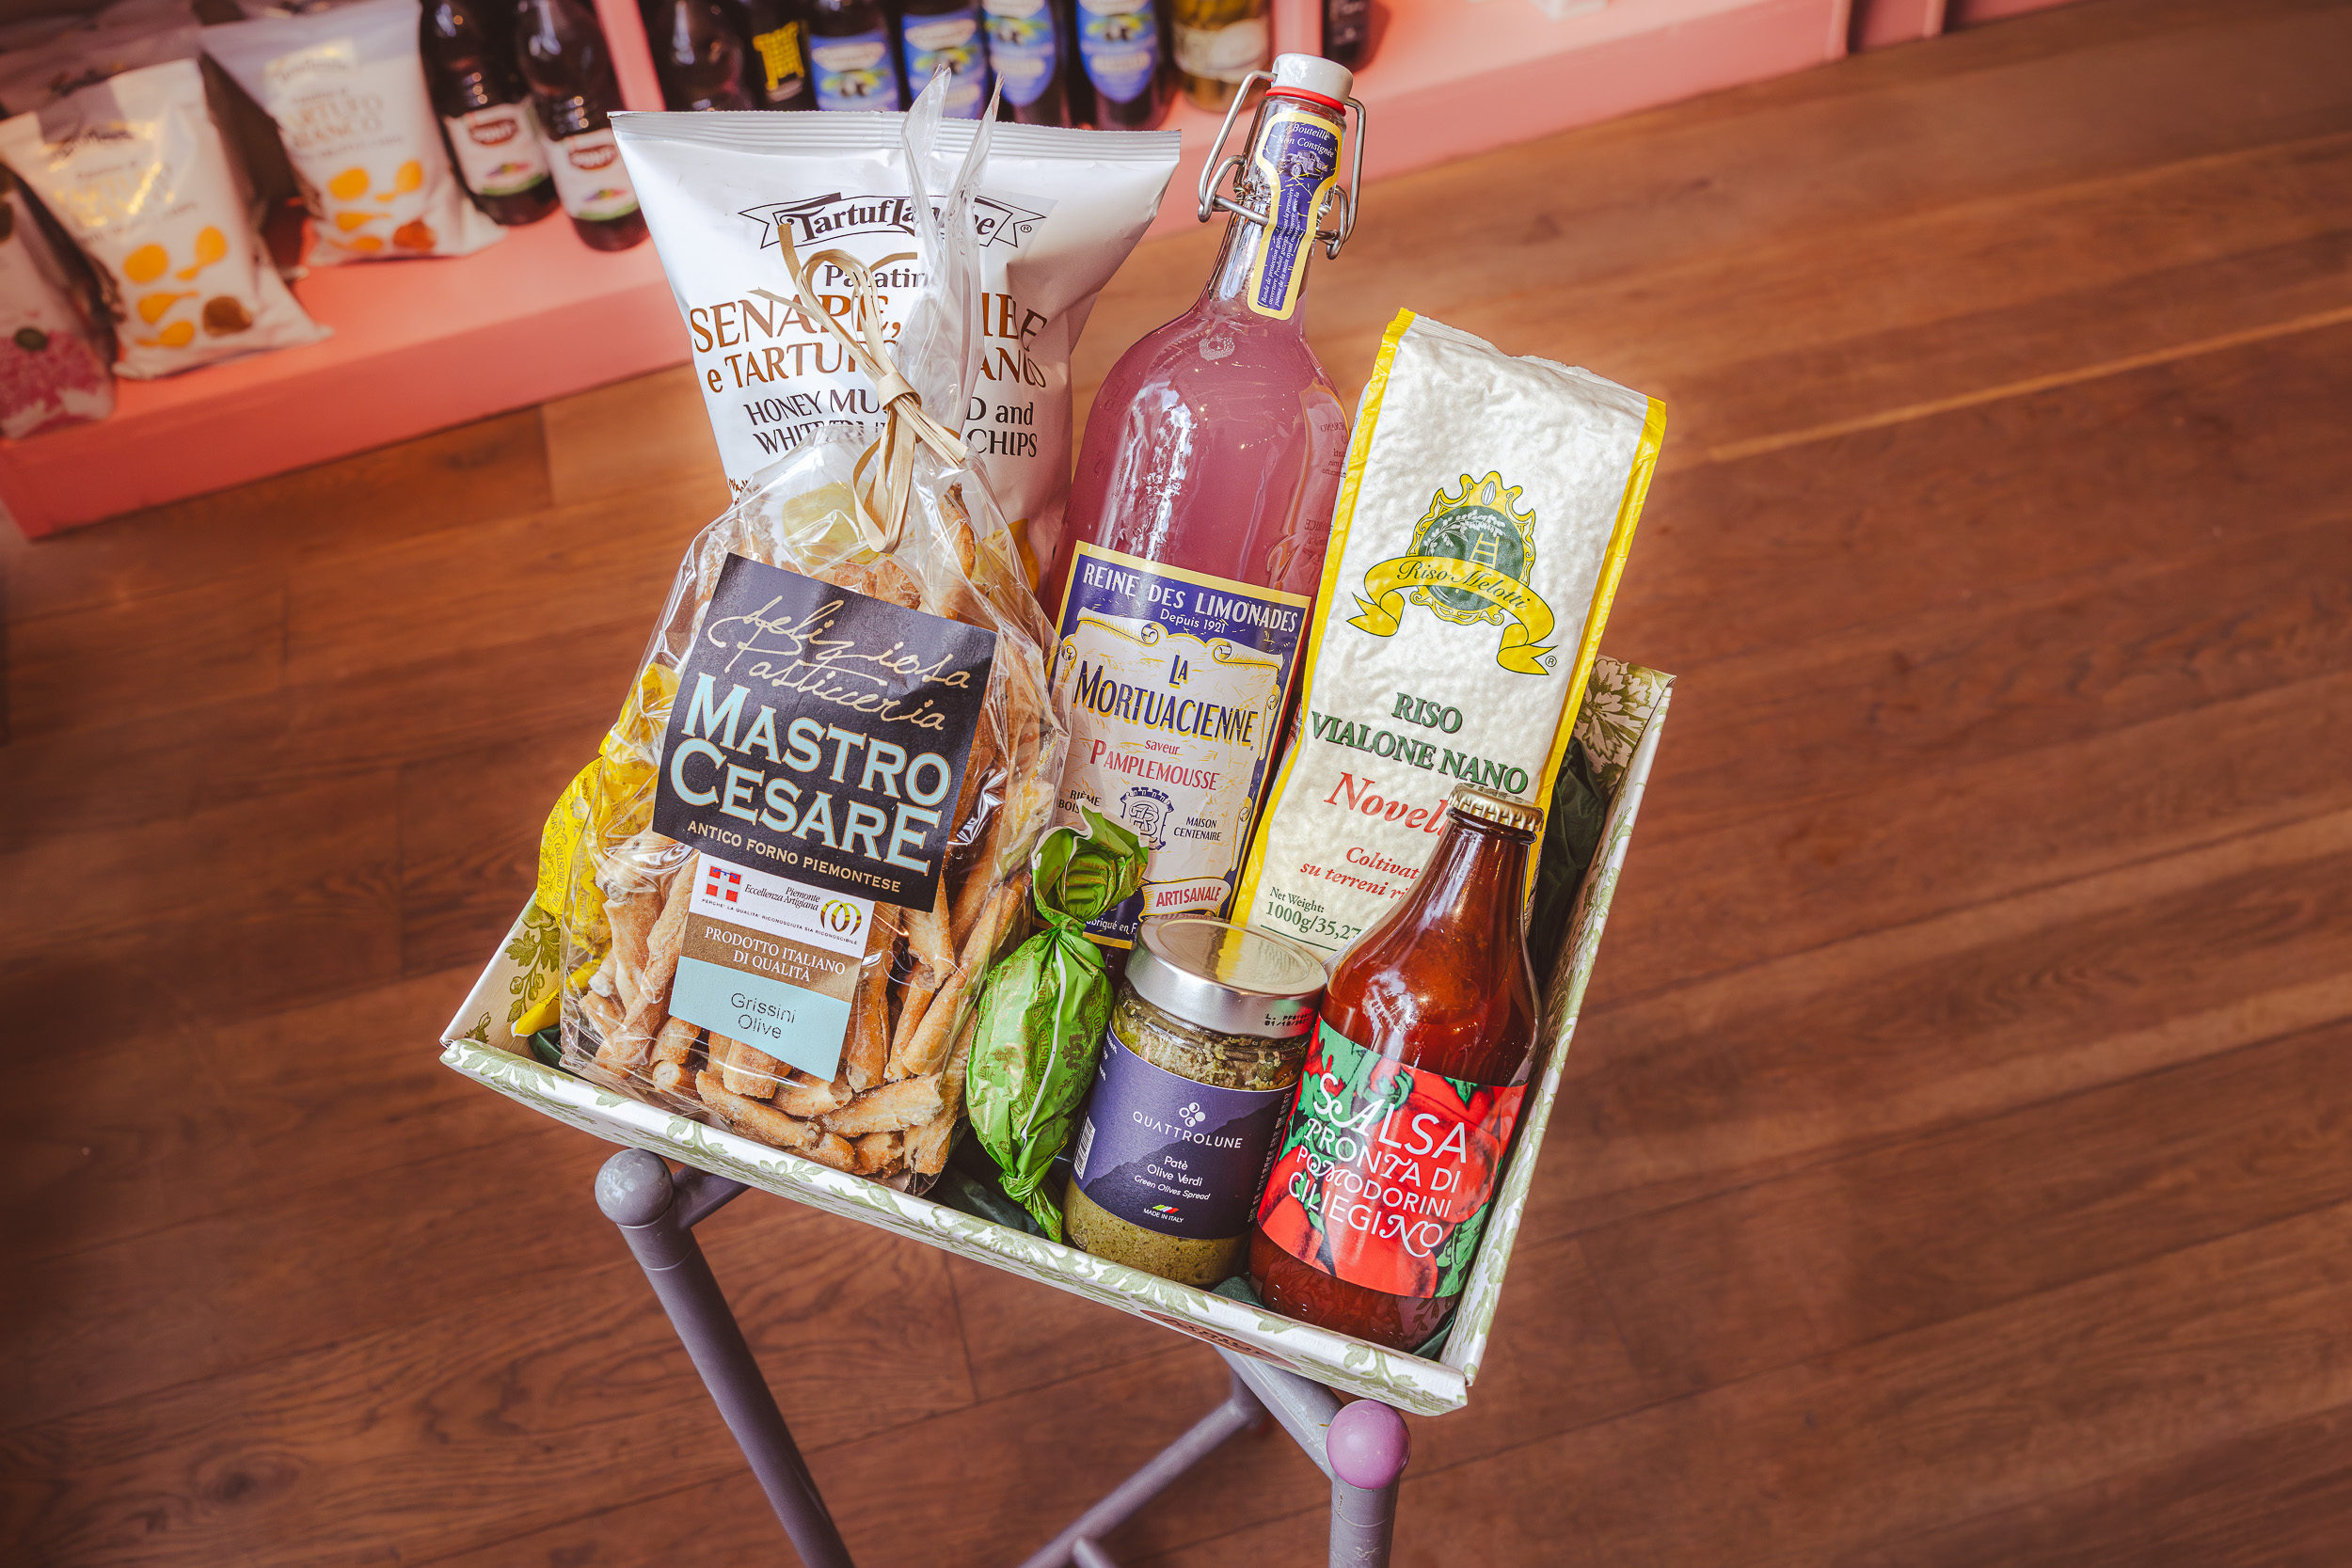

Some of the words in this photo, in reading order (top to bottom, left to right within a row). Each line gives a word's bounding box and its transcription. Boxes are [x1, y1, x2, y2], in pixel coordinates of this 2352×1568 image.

[1297, 137, 1334, 158] Consignée
[1267, 249, 1279, 277] protection
[1274, 256, 1283, 276] Produit
[707, 368, 723, 393] e
[743, 390, 823, 426] HONEY
[994, 401, 1034, 426] and
[1083, 562, 1140, 598] REINE
[1148, 583, 1186, 610] DES
[1194, 592, 1298, 633] LIMONADES
[1397, 560, 1453, 581] Riso
[1449, 569, 1532, 610] Melotti
[1160, 609, 1200, 629] Depuis
[1203, 619, 1226, 634] 1921
[1168, 655, 1189, 689] LA
[1073, 660, 1259, 746] MORTUACIENNE
[1391, 691, 1463, 734] RISO
[681, 672, 951, 806] MASTRO
[1144, 739, 1180, 755] saveur
[1311, 711, 1437, 770] VIALONE
[1438, 748, 1529, 795] NANO
[1089, 739, 1220, 791] PAMPLEMOUSSE
[670, 737, 942, 877] CESARE
[1186, 816, 1217, 829] MAISON
[1173, 827, 1222, 841] CENTENAIRE
[555, 842, 565, 890] CHIOSTRO
[687, 820, 742, 847] ANTICO
[745, 839, 799, 865] FORNO
[803, 856, 901, 893] PIEMONTESE
[1346, 847, 1421, 879] Coltivat
[1300, 863, 1321, 877] su
[1325, 867, 1389, 895] terreni
[551, 890, 563, 909] DEL
[744, 884, 784, 902] Eccellenza
[784, 895, 819, 911] Artigiana
[785, 887, 820, 903] Piemonte
[1156, 887, 1222, 908] ARTISANALE
[1270, 886, 1286, 901] Net
[1289, 893, 1325, 913] Weight:
[762, 915, 803, 930] RICONOSCIUTA
[815, 929, 857, 945] RICONOSCIBILE
[1119, 924, 1129, 932] en
[705, 927, 779, 957] PRODOTTO
[781, 943, 846, 974] ITALIANO
[733, 950, 748, 964] DI
[752, 955, 810, 982] QUALITÀ
[730, 992, 797, 1023] Grissini
[738, 1014, 782, 1039] Olive
[1132, 1111, 1244, 1148] QUATTROLUNE
[1312, 1072, 1467, 1164] SALSA
[1164, 1155, 1188, 1170] Patè
[1303, 1117, 1422, 1187] PRONTA
[1430, 1166, 1461, 1194] DI
[1134, 1175, 1156, 1189] Green
[1157, 1183, 1181, 1196] Olives
[1182, 1189, 1211, 1201] Spread
[1147, 1164, 1174, 1180] Olive
[1178, 1172, 1202, 1187] Verdi
[1295, 1146, 1453, 1219] POMODORINI
[1143, 1208, 1161, 1219] MADE
[1168, 1214, 1184, 1223] ITALY
[1288, 1171, 1443, 1259] CILIEGINO
